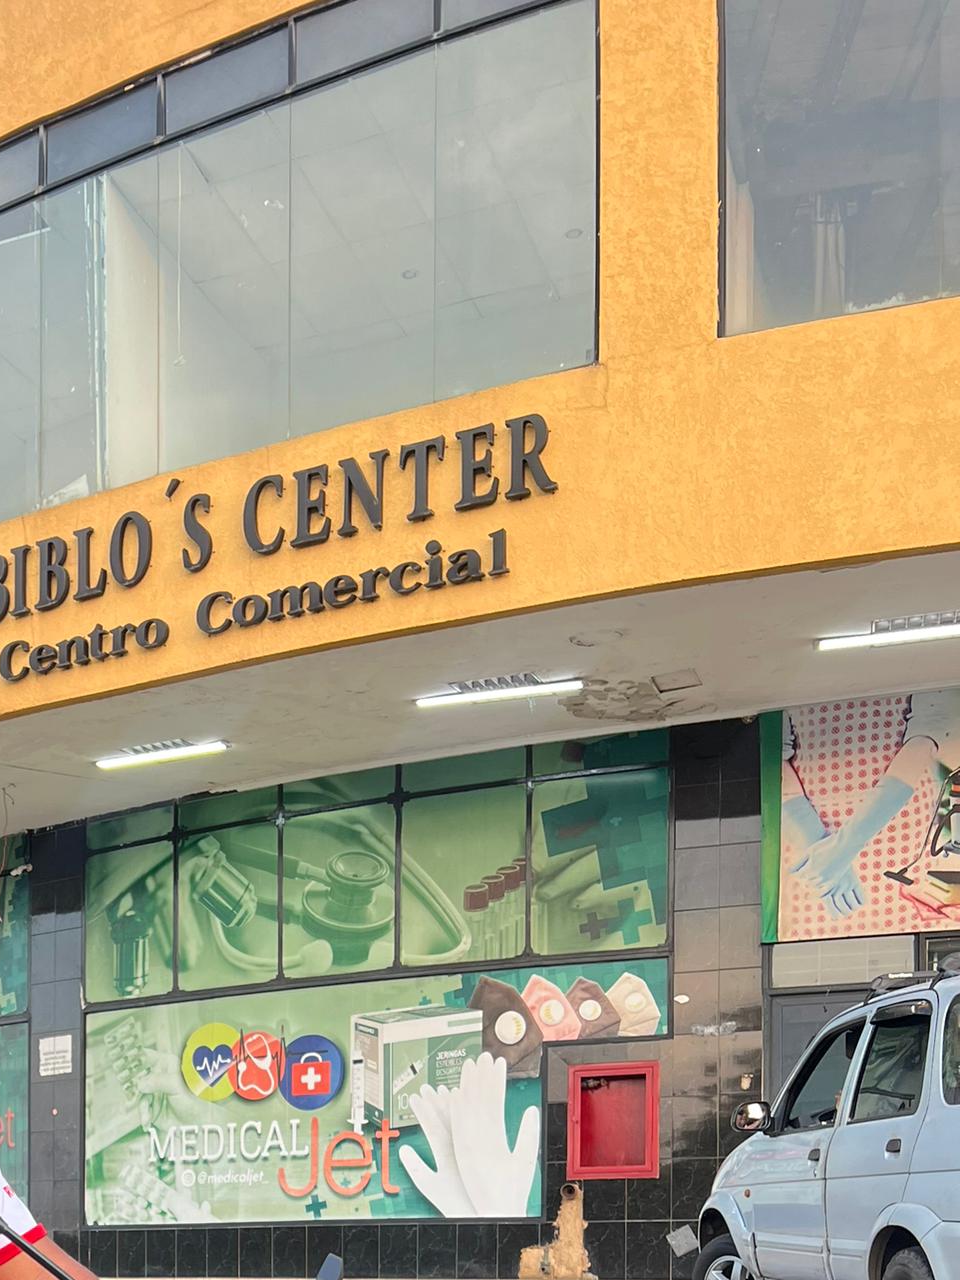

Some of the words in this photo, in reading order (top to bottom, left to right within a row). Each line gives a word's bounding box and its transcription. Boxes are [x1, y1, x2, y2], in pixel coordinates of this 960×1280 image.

[242, 413, 559, 555] CENTER
[196, 529, 511, 635] Comercial
[148, 1119, 310, 1162] MEDICAL
